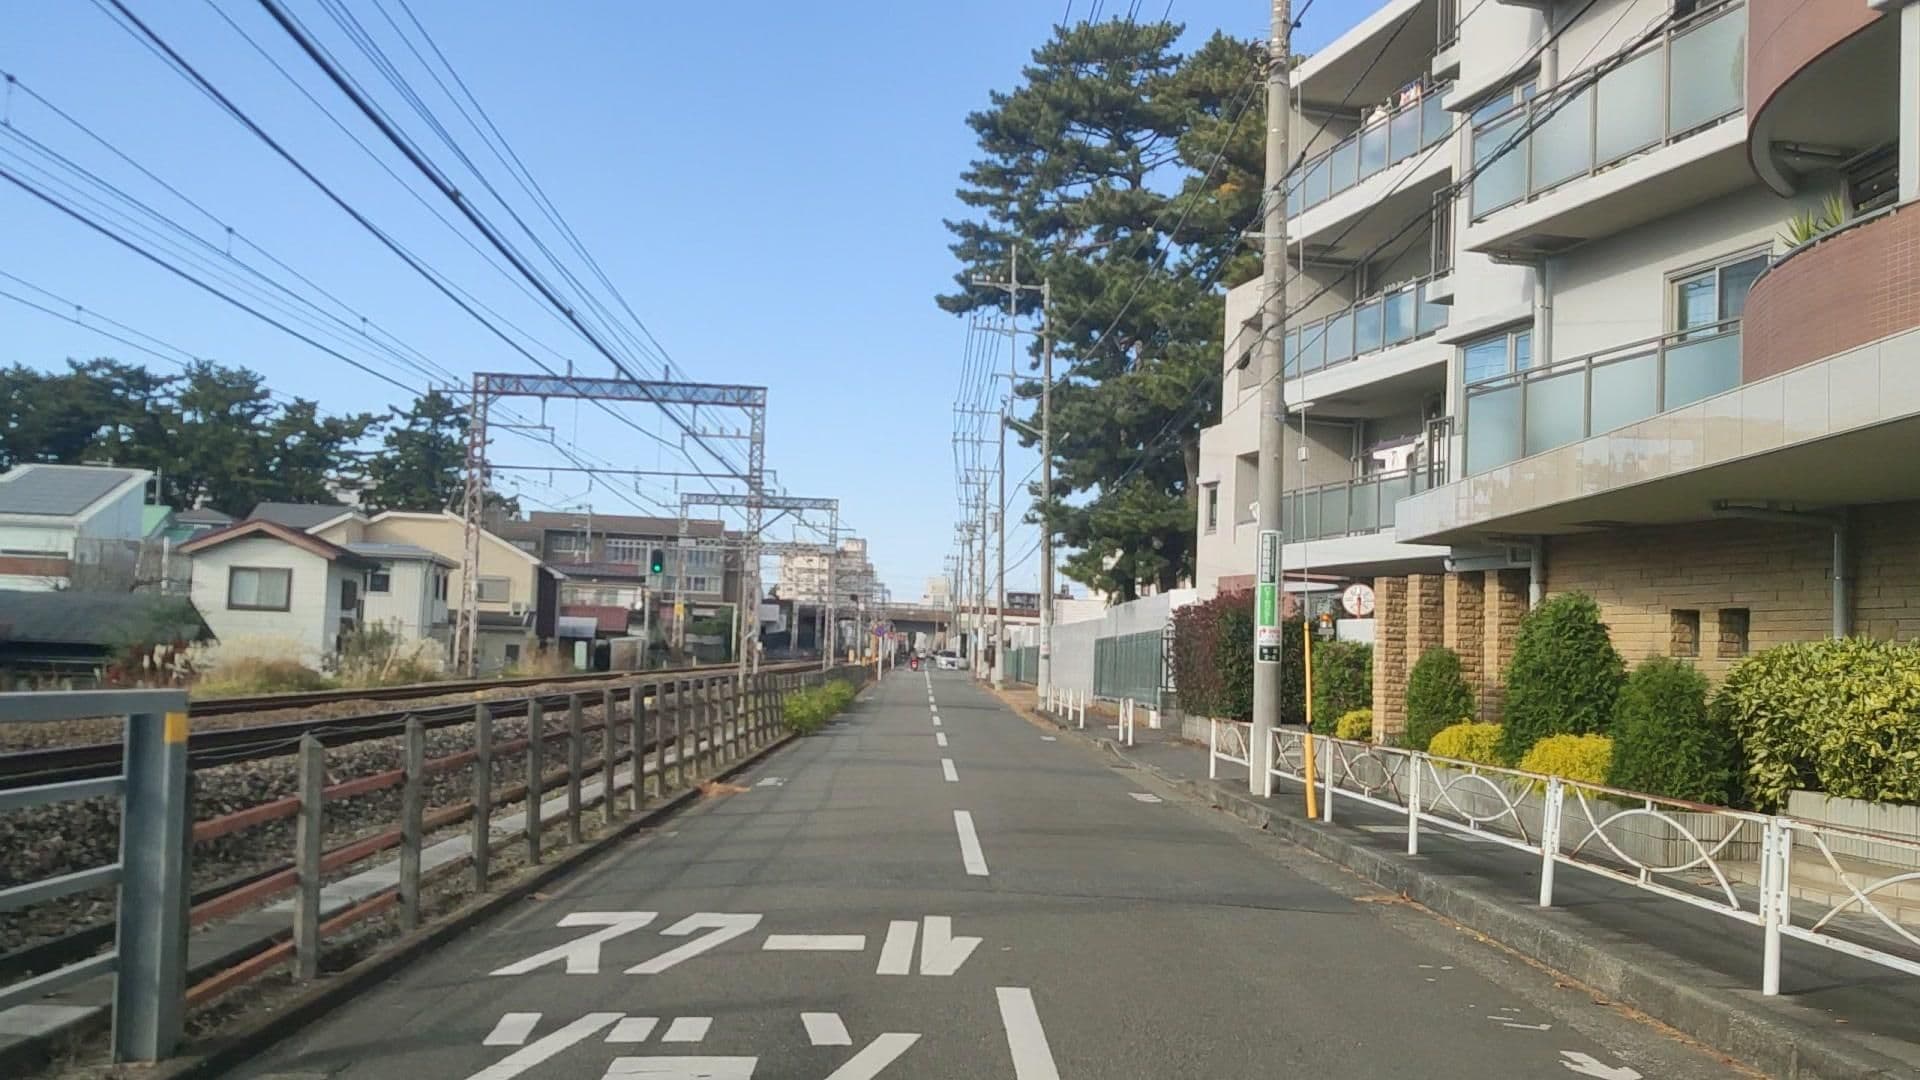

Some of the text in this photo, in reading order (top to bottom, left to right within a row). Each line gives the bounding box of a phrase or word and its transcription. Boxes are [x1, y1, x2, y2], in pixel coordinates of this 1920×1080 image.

[489, 911, 983, 976] スクール
[465, 1012, 922, 1080] ゾーン
